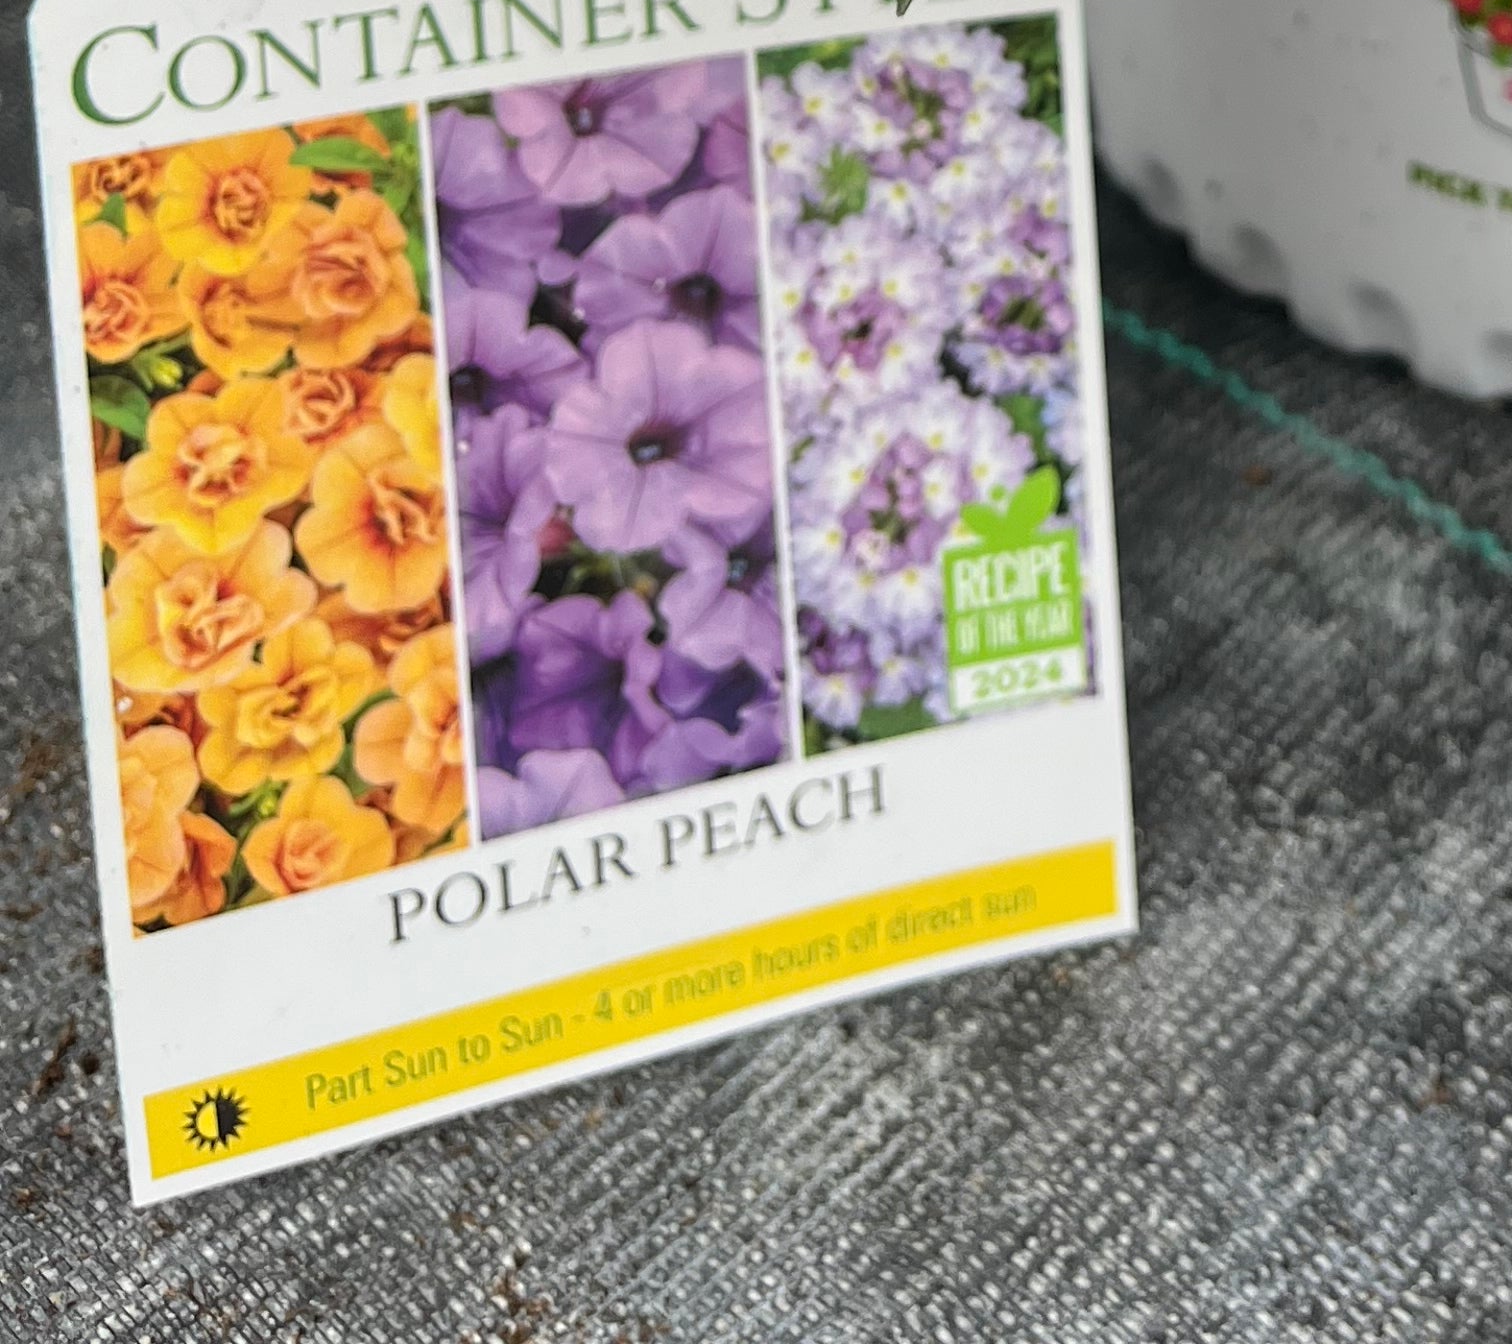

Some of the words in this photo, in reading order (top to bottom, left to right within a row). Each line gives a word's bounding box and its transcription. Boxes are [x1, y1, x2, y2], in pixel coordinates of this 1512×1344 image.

[954, 541, 1071, 612] RECIPE
[971, 657, 1063, 700] 2024
[387, 831, 638, 944] POLAR
[656, 762, 889, 870] PEACH
[305, 1063, 374, 1110] Part
[382, 1045, 449, 1089] Sun
[457, 1031, 491, 1065] to
[500, 1011, 564, 1054] Sun
[592, 989, 614, 1023] 4
[622, 981, 657, 1017] or
[663, 960, 747, 1007] more
[751, 932, 843, 981] hours
[846, 911, 880, 956] of
[886, 896, 974, 945] direct
[983, 884, 1037, 921] sun
